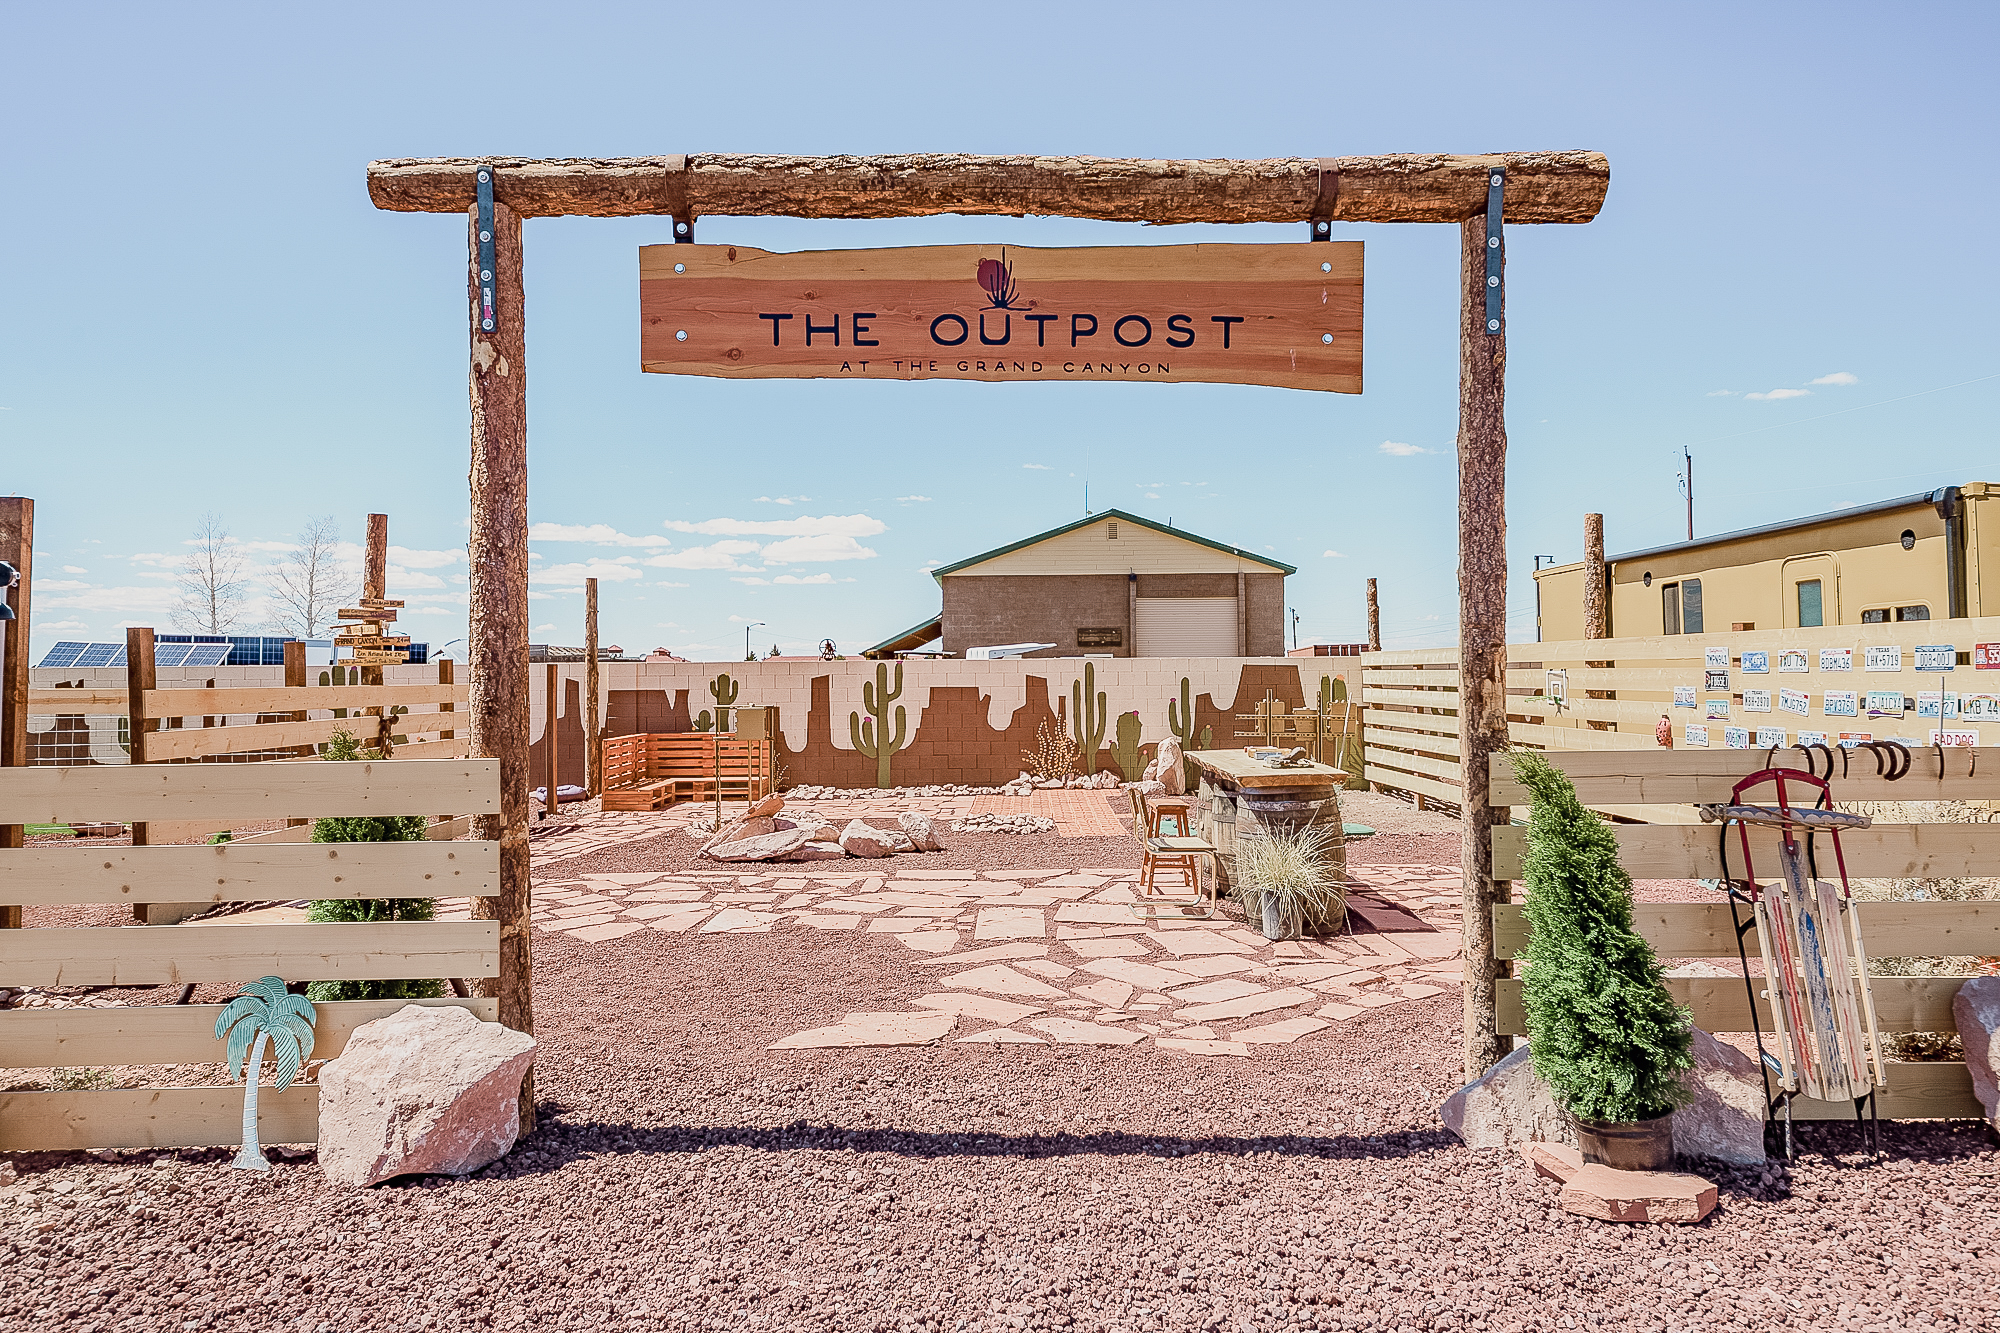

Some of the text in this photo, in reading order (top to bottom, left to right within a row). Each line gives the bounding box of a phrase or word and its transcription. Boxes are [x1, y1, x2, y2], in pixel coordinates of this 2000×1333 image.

[758, 312, 1245, 349] THE OUTPOST
[839, 361, 1170, 374] AT THE GRAND CANYON
[1954, 734, 1975, 746] DOG
